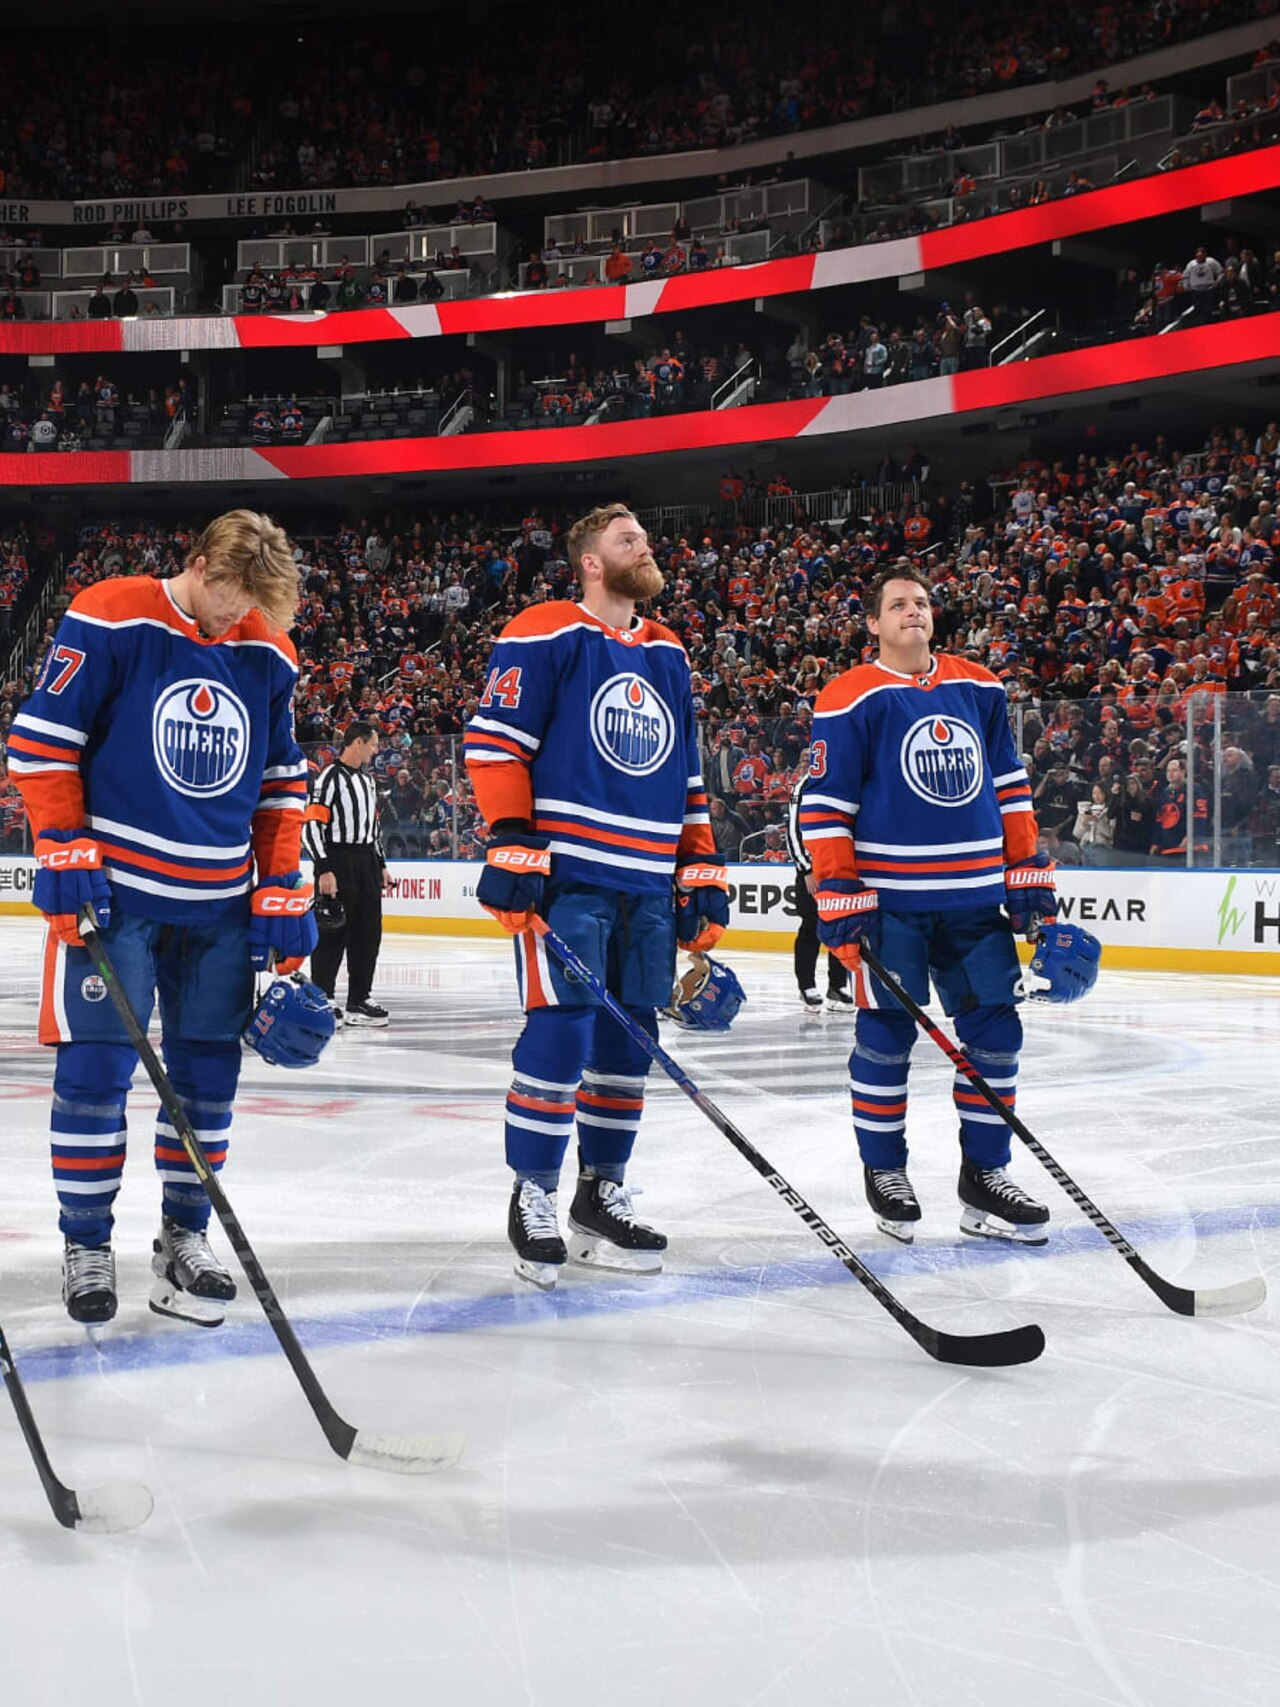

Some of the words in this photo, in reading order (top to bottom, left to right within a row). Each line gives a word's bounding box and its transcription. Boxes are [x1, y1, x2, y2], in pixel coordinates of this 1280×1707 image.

[73, 205, 106, 223] ROD
[113, 201, 189, 221] PHILLIPS
[227, 198, 256, 216] LEE
[263, 194, 337, 215] FOGOLIN
[479, 666, 523, 709] 14
[163, 717, 239, 771] OILERS
[604, 706, 661, 754] OILERS
[809, 739, 827, 779] 3
[914, 746, 975, 785] OILERS
[0, 868, 12, 891] THE
[429, 878, 441, 899] IN
